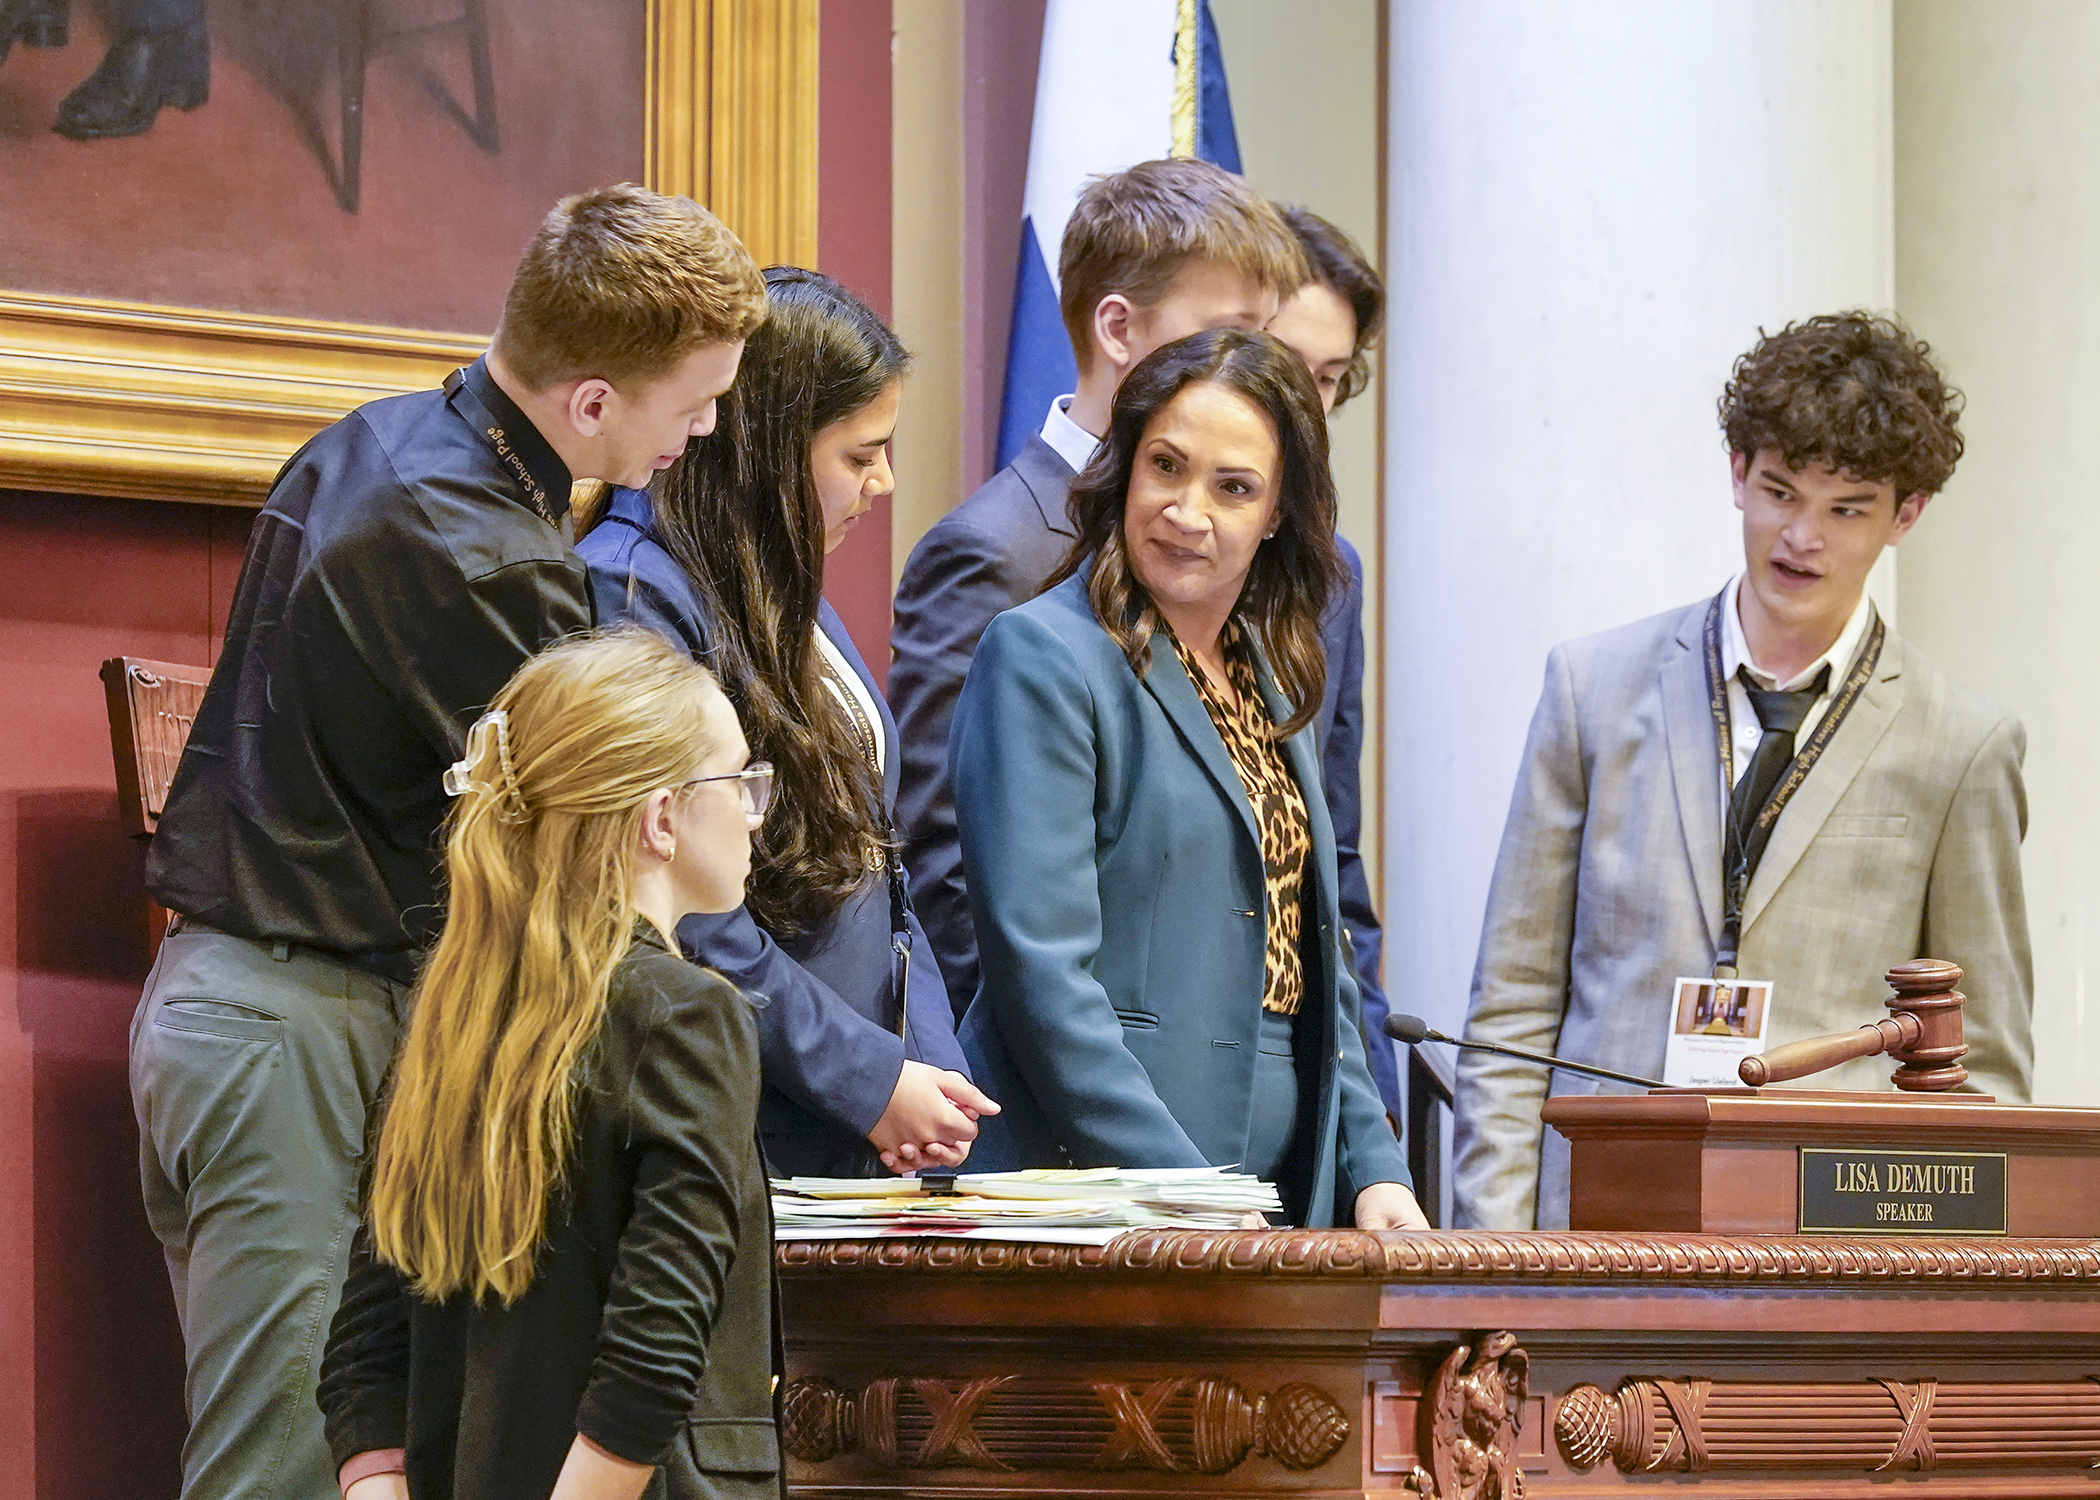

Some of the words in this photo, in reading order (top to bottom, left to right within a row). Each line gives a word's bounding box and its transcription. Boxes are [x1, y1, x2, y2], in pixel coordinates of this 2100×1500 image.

[487, 427, 510, 455] Page
[504, 452, 535, 492] School
[532, 488, 547, 518] High
[836, 678, 859, 710] House
[1815, 671, 1868, 745] Representatives
[857, 711, 880, 773] Minnesota
[1796, 744, 1821, 770] High
[1776, 769, 1804, 806] School
[1759, 802, 1781, 828] Page
[1834, 1162, 1880, 1193] LISA
[1886, 1163, 1975, 1194] DEMUTH
[1876, 1202, 1934, 1222] SPEAKER
